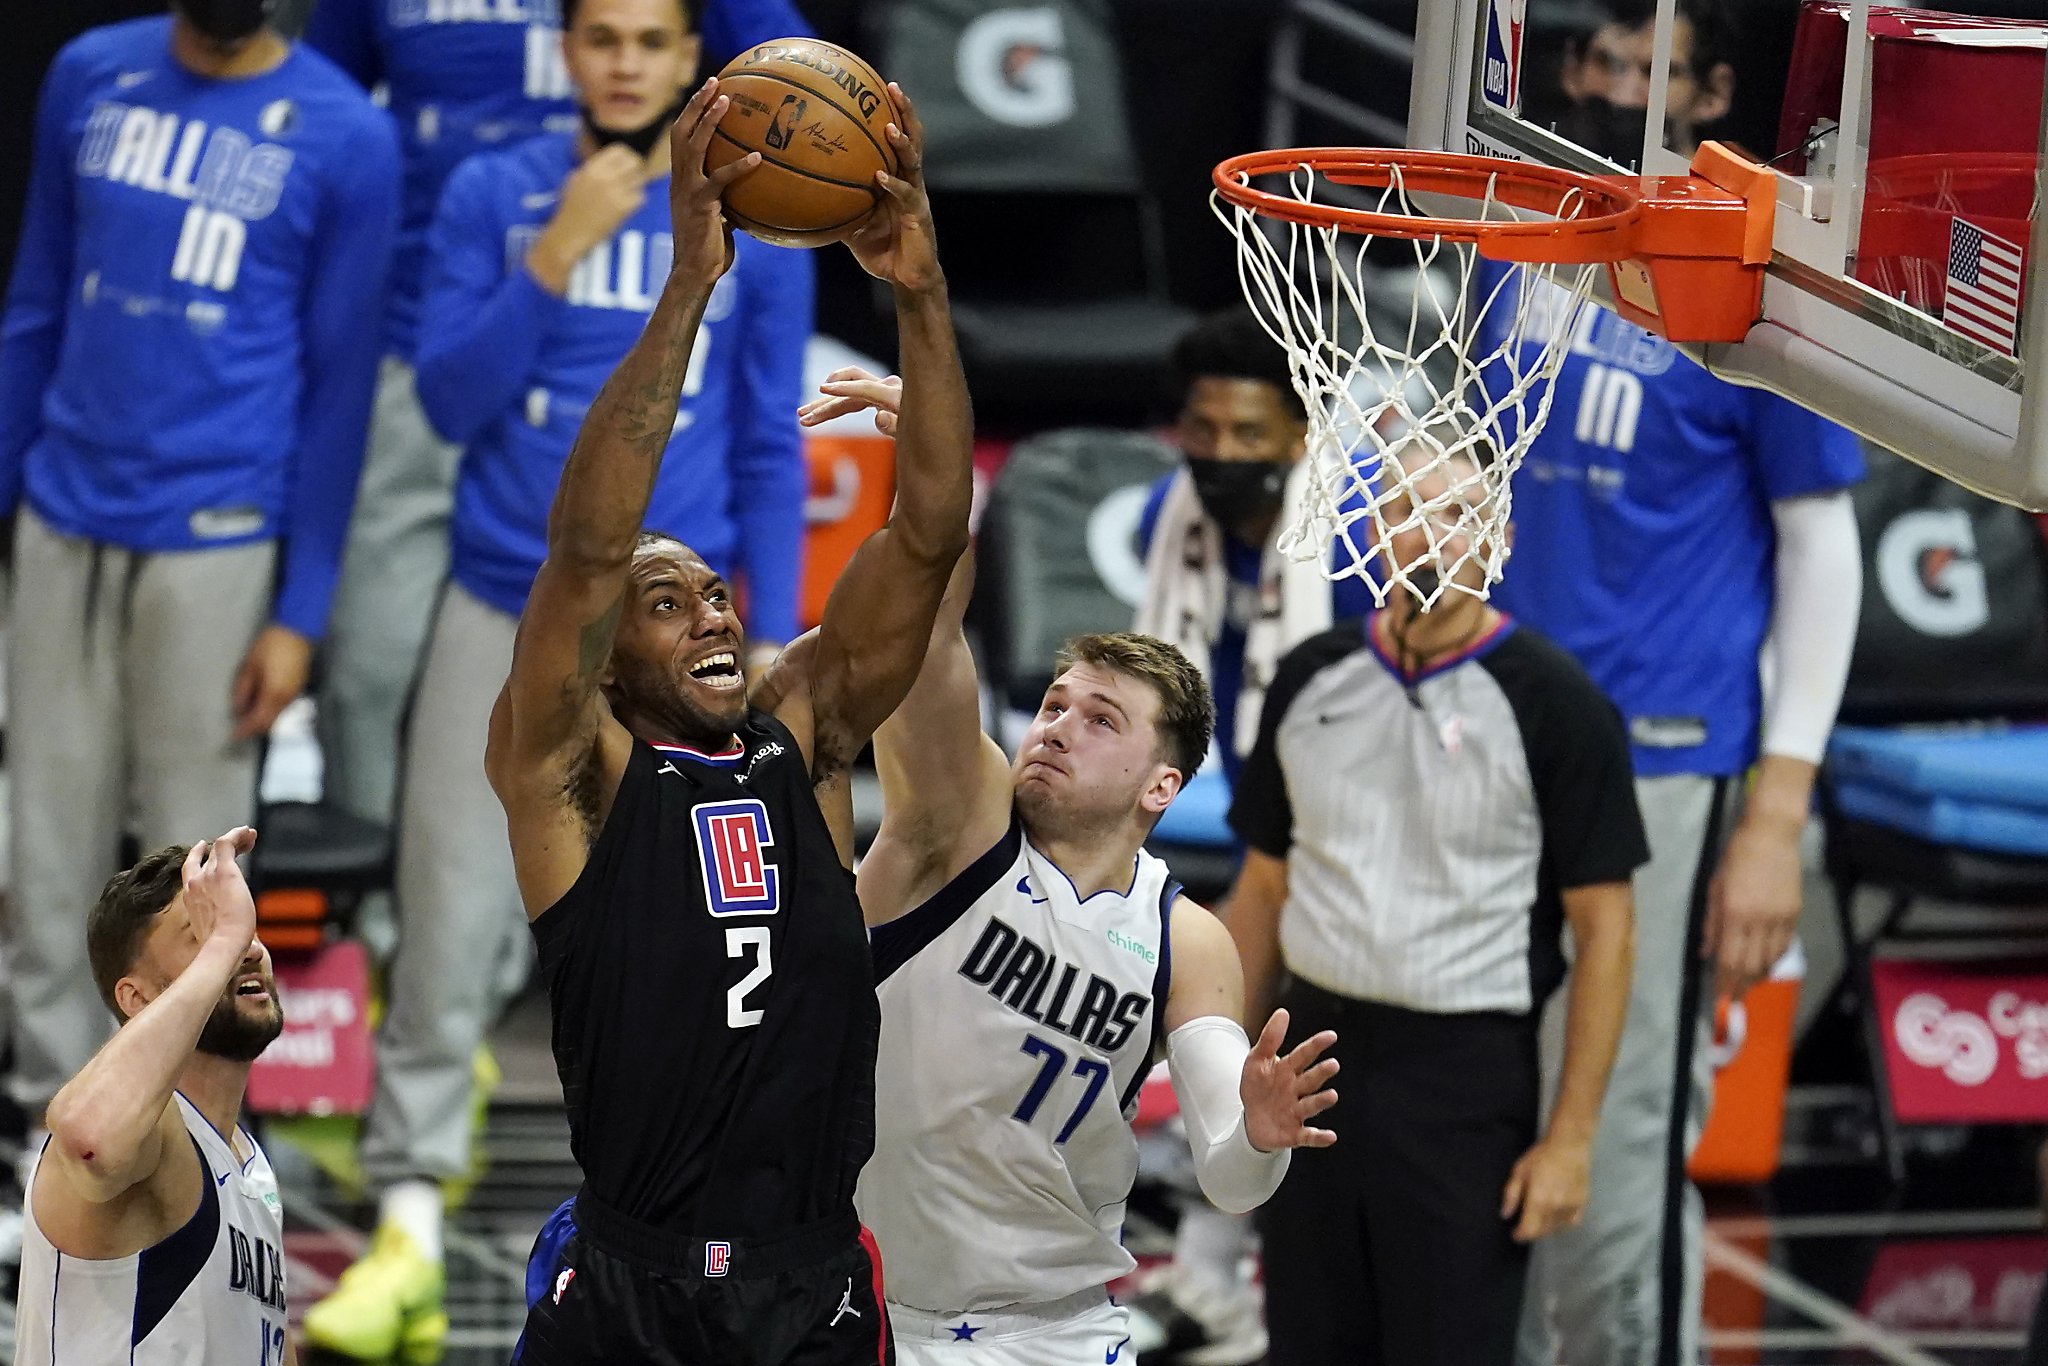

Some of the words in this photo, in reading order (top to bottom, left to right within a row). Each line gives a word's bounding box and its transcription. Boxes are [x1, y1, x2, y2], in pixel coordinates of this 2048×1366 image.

[744, 46, 881, 119] SPALDING
[956, 8, 1075, 127] G
[1486, 57, 1506, 96] NBA
[77, 102, 297, 221] DALLAS
[171, 202, 246, 292] IN
[1575, 363, 1643, 453] IN
[1877, 509, 1989, 637] G
[726, 926, 773, 1029] 2
[957, 915, 1154, 1053] DALLAS
[1107, 929, 1156, 965] chime
[1010, 1032, 1111, 1146] 77
